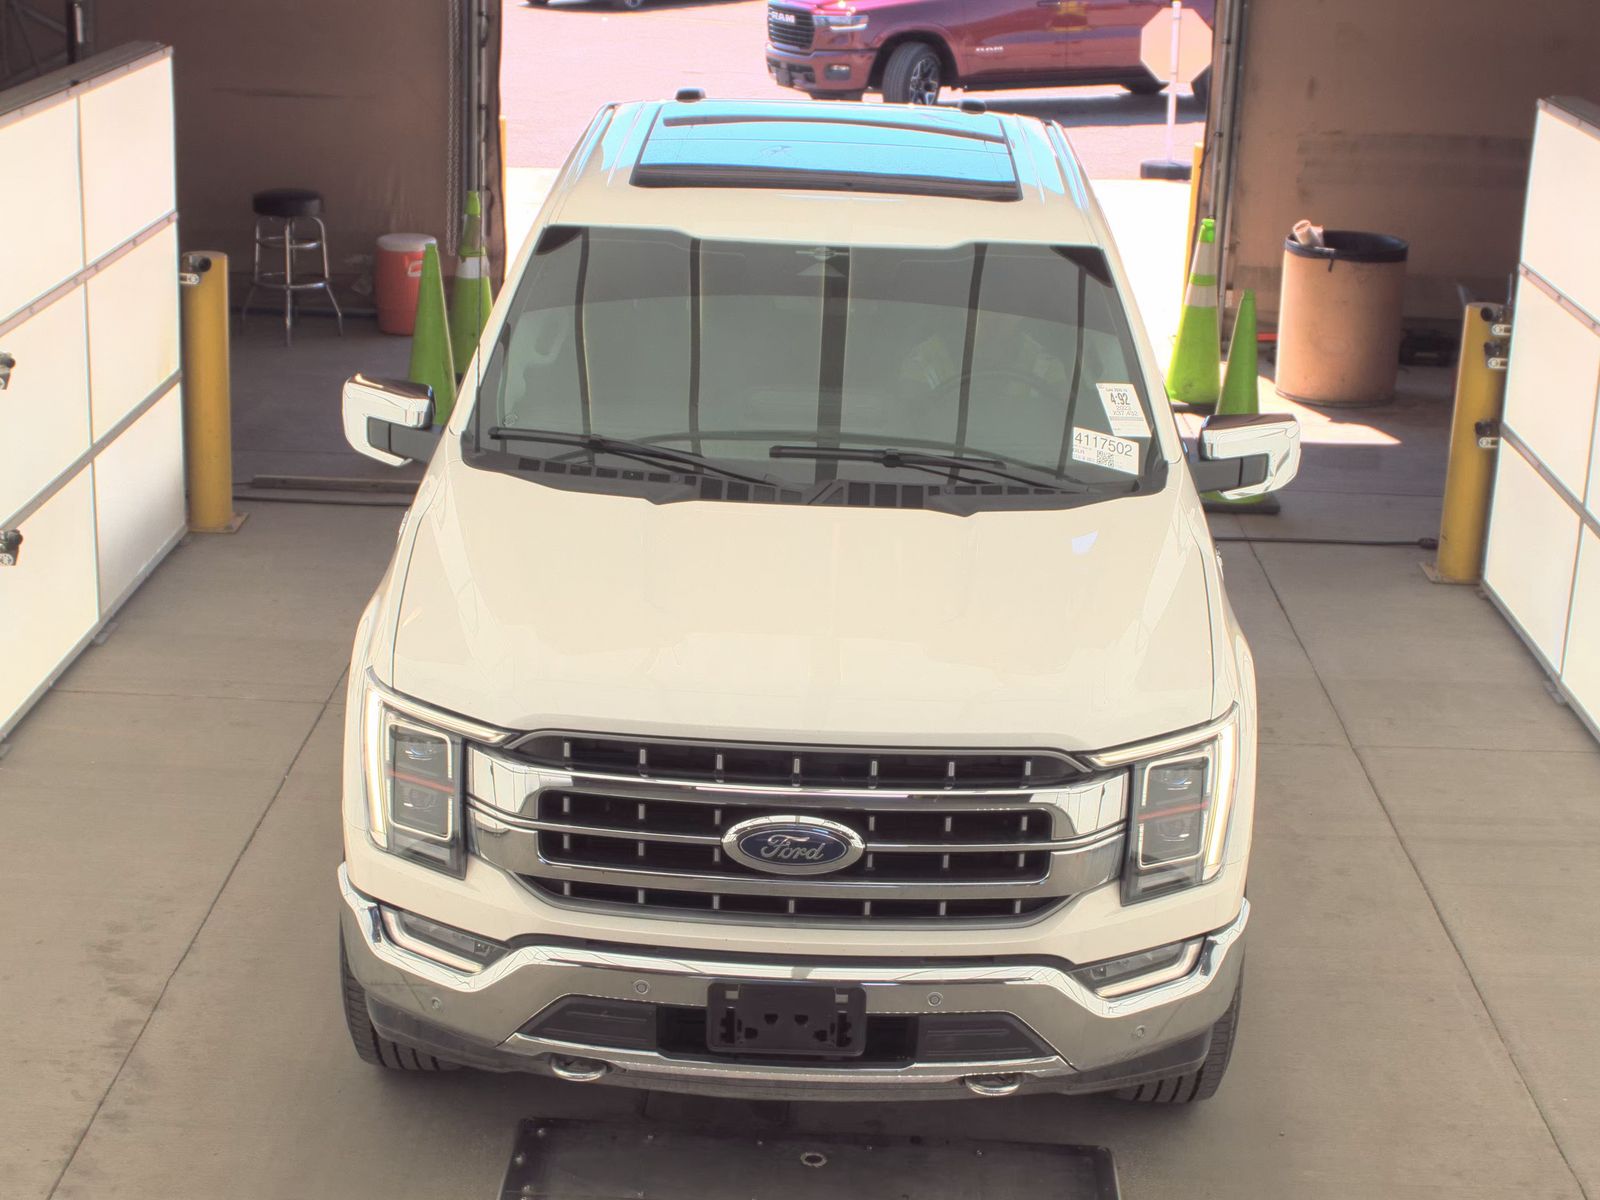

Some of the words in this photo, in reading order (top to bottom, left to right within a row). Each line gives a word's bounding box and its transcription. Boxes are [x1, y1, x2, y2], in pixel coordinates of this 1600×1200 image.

[771, 11, 795, 23] RAM
[1074, 432, 1133, 457] 4117502
[760, 834, 826, 860] Ford
